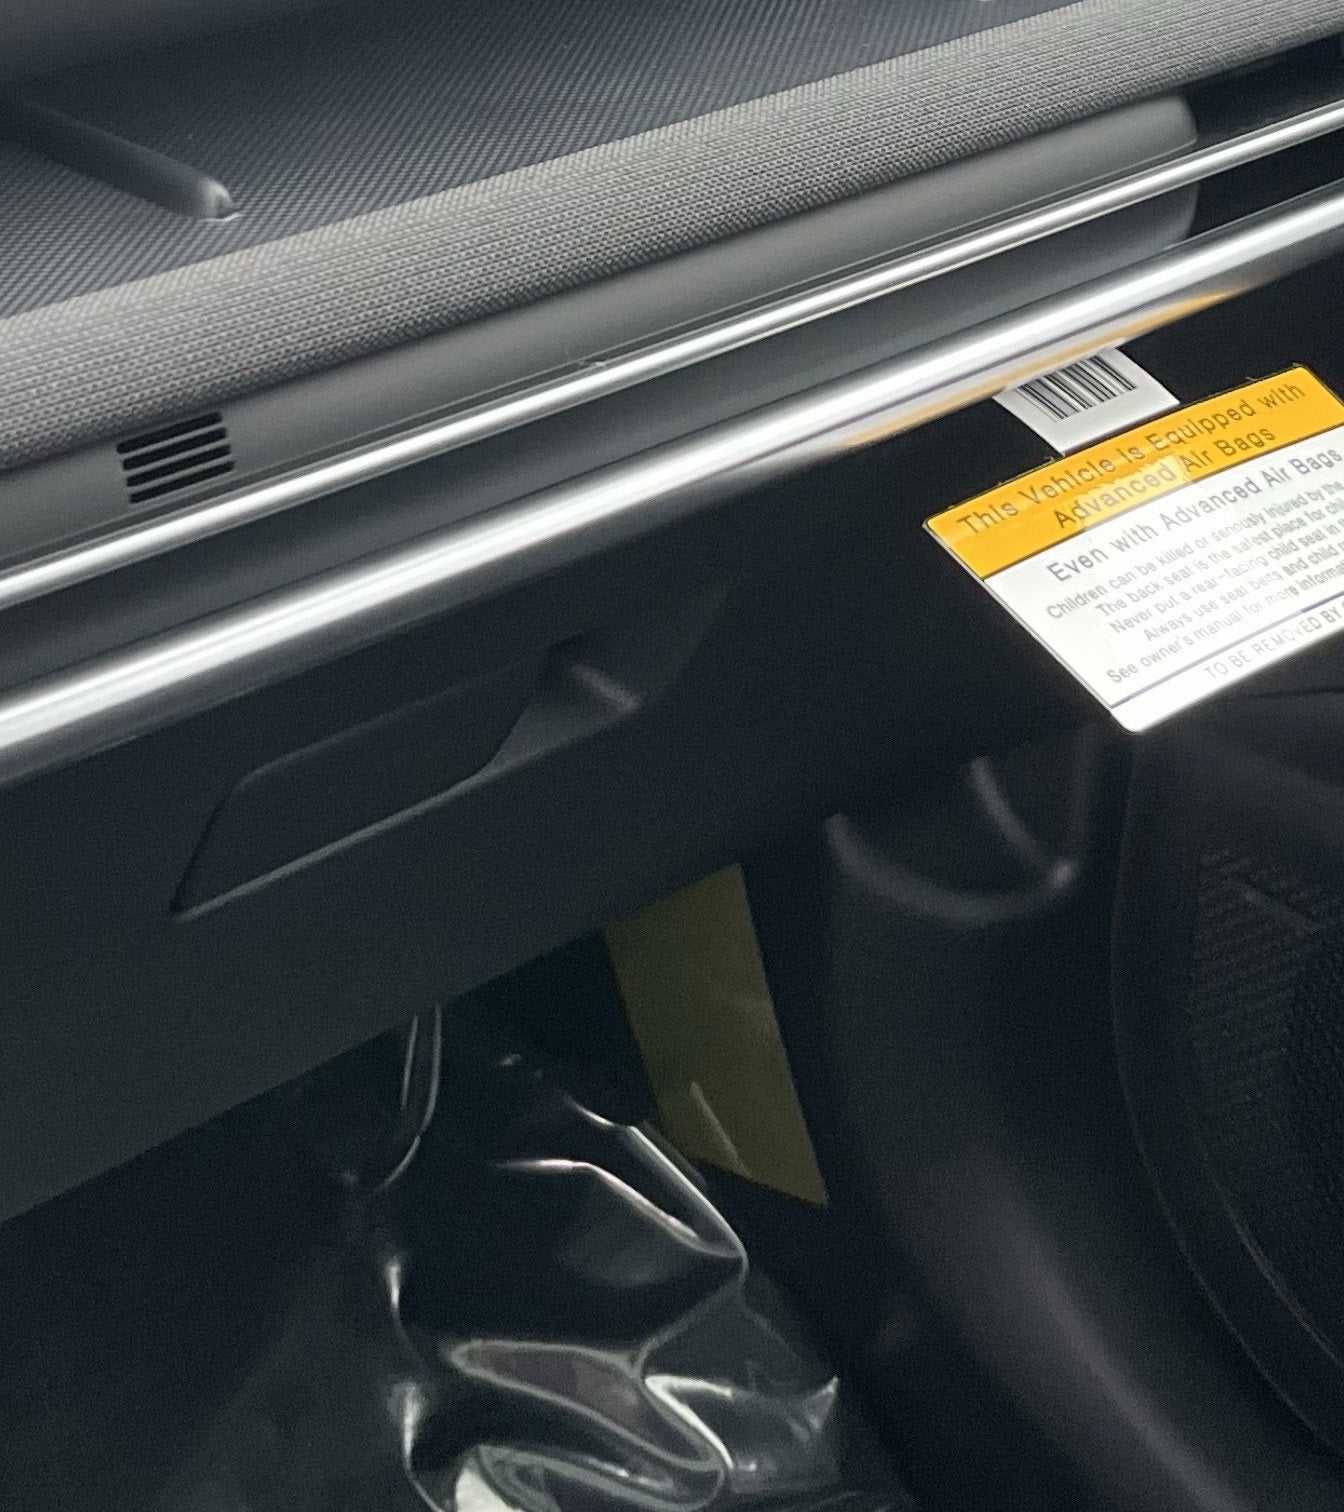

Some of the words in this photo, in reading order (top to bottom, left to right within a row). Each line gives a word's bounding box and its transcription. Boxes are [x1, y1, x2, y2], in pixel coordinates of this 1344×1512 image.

[957, 502, 1019, 533] This
[1018, 459, 1116, 504] Vehicle
[1146, 399, 1256, 451] Equipped
[1257, 384, 1306, 409] with
[1054, 459, 1177, 529] Advanced
[1179, 449, 1214, 473] Air
[1213, 428, 1276, 457] Bags
[1046, 548, 1109, 582] Even
[1109, 524, 1159, 553] with
[1159, 477, 1261, 530] Advanced
[1260, 467, 1292, 487] Air
[1289, 449, 1343, 475] Bags
[1046, 584, 1108, 620] Children
[1109, 571, 1137, 590] can
[1136, 560, 1157, 576] be
[1157, 543, 1194, 566] killed
[1195, 535, 1209, 549] or
[1263, 494, 1308, 519] injured
[1306, 489, 1325, 502] by
[1321, 481, 1344, 495] the
[1095, 598, 1127, 617] The
[1127, 581, 1164, 603] back
[1164, 566, 1194, 586] seat
[1208, 550, 1232, 565] the
[1272, 517, 1307, 539] place
[1304, 509, 1326, 523] for
[1109, 608, 1155, 634] Never
[1155, 595, 1180, 614] put
[1268, 539, 1299, 560] child
[1298, 528, 1328, 547] seat
[1325, 524, 1342, 536] in
[1142, 613, 1193, 641] Always
[1193, 599, 1218, 617] use
[1220, 586, 1249, 604] seat
[1282, 557, 1308, 577] and
[1308, 544, 1340, 565] child
[1106, 664, 1139, 683] See
[1140, 637, 1195, 667] owner's
[1193, 612, 1244, 640] manual
[1241, 601, 1263, 616] for
[1265, 585, 1300, 606] more
[1203, 662, 1229, 679] TO
[1229, 648, 1251, 668] BE
[1251, 615, 1322, 656] REMOVED
[1320, 605, 1343, 624] BY
